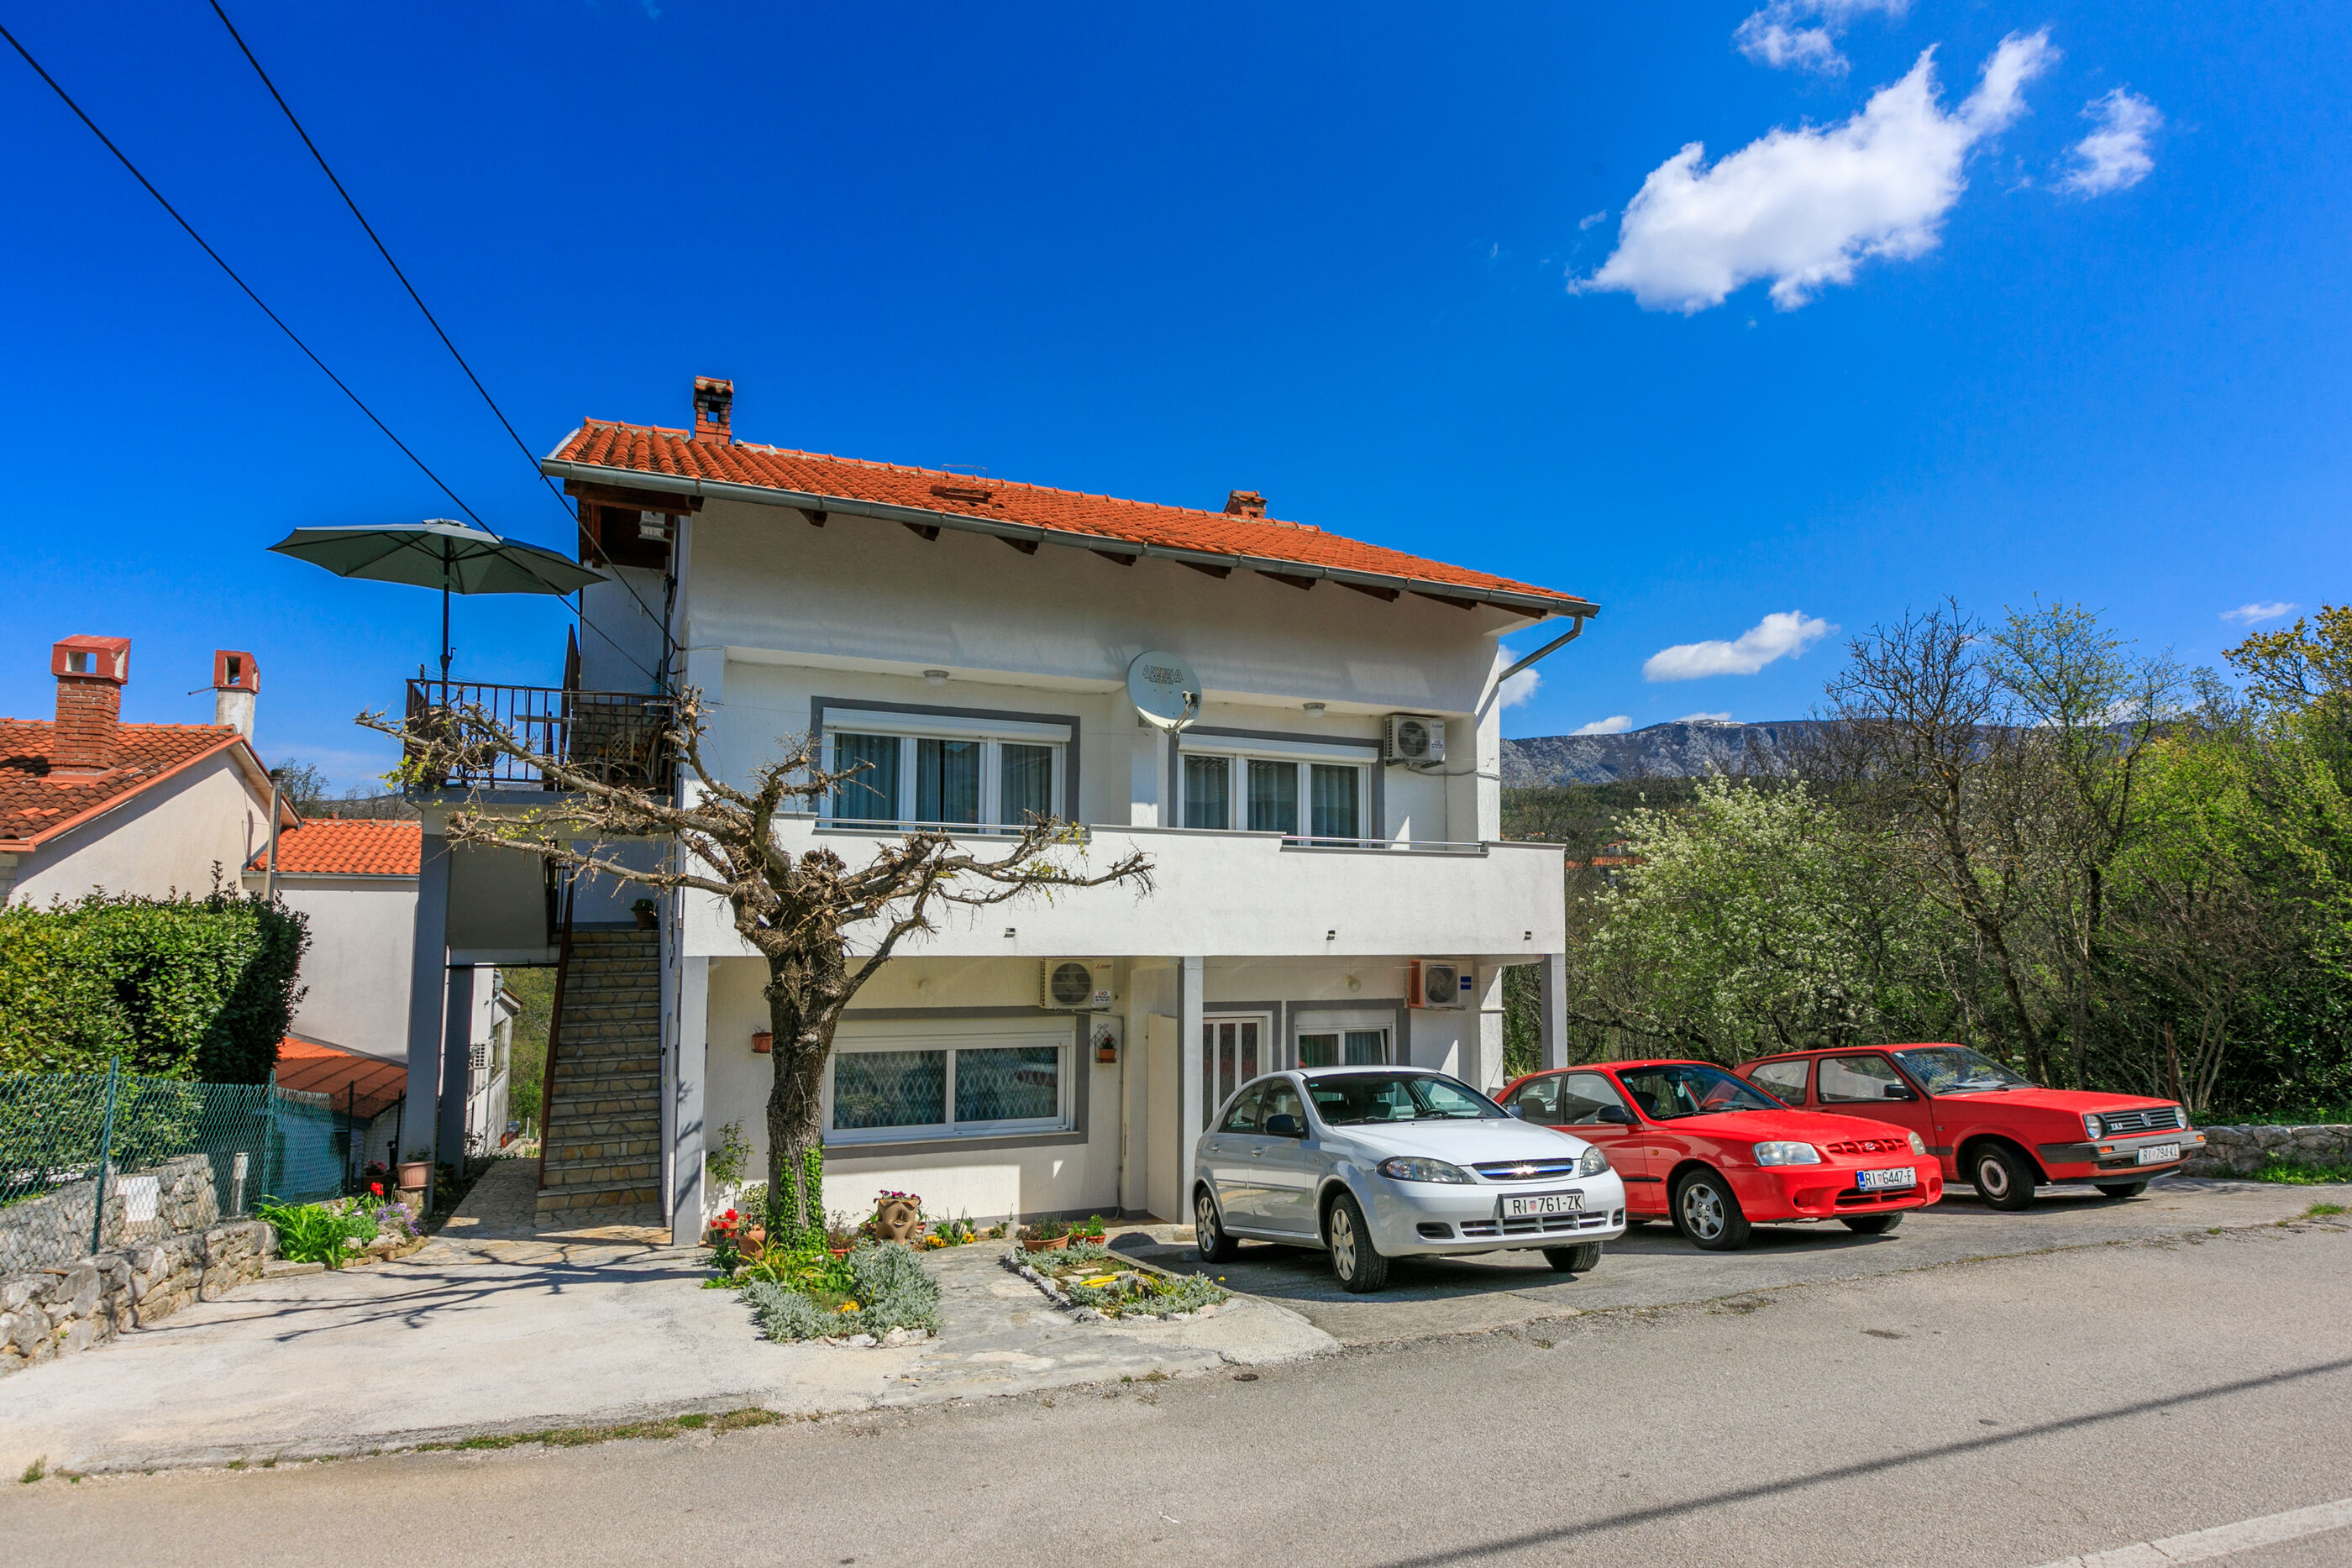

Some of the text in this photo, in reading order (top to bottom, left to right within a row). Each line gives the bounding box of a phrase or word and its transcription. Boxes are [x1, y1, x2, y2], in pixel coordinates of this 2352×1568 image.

[1142, 664, 1184, 680] ANTENA
[2144, 1149, 2151, 1161] RI
[1865, 1170, 1912, 1186] RI 6447-F
[1513, 1195, 1583, 1214] RI 761-ZK
